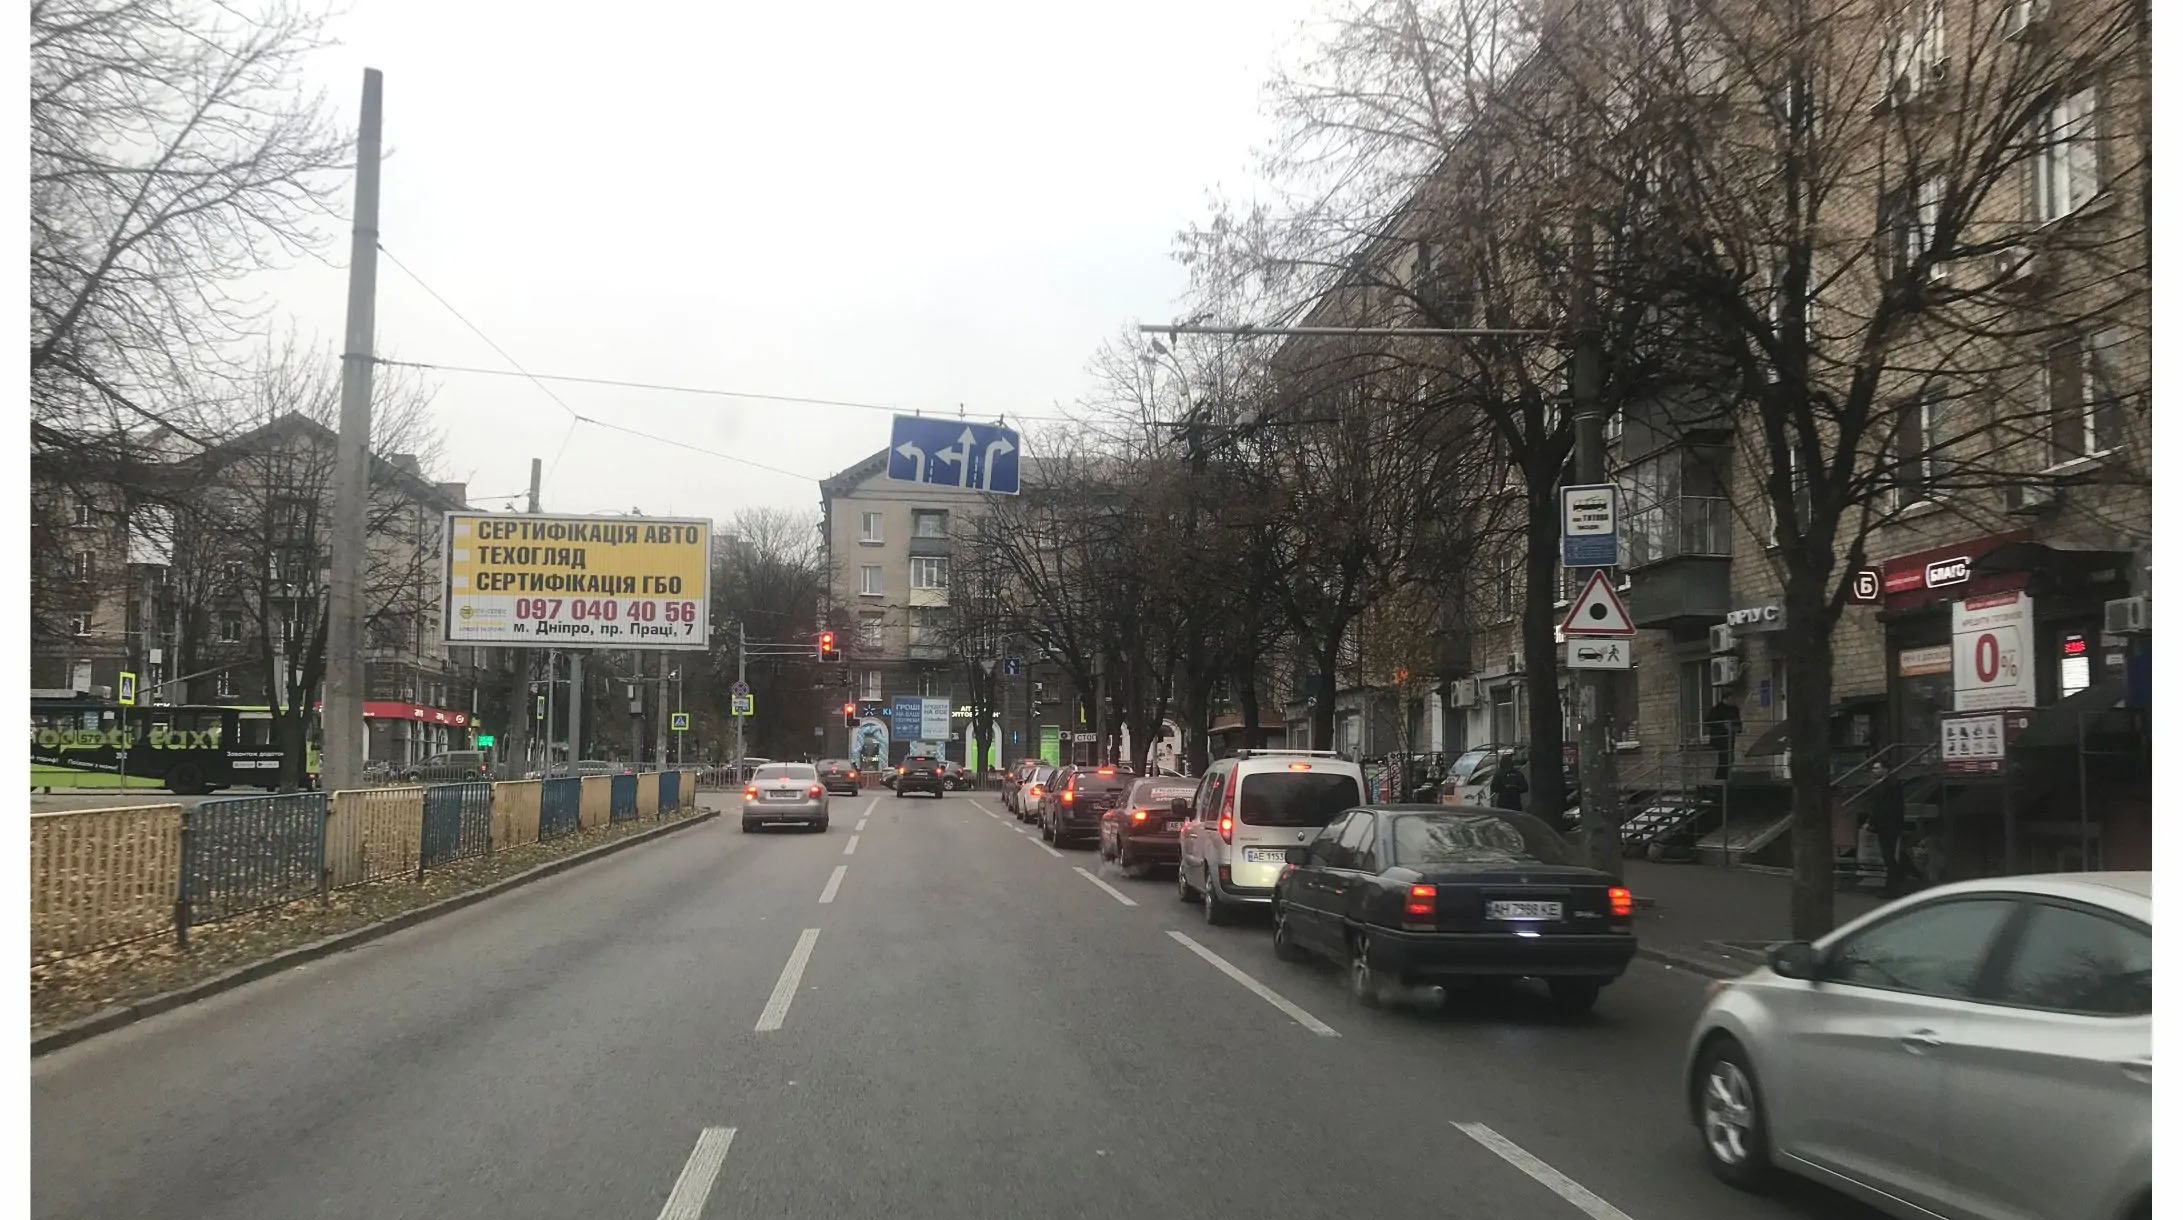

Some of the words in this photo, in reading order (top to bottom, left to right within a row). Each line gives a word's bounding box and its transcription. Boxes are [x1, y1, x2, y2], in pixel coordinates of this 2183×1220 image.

[478, 521, 638, 546] СЕРТИФІКАЦІЯ
[644, 525, 698, 545] АВТО
[478, 546, 586, 569] ТЕХОГЛЯД
[476, 572, 635, 595] СЕРТИФІКАЦІЯ
[642, 576, 682, 595] ГБО
[1860, 577, 1873, 594] Б
[516, 598, 562, 620] 097
[571, 600, 617, 621] 040
[627, 601, 656, 622] 40
[665, 602, 696, 622] 56
[514, 623, 529, 633] м.
[536, 620, 594, 637] Дніпро,
[600, 625, 623, 637] пр.
[630, 623, 677, 638] Праці,
[684, 624, 694, 636] 7
